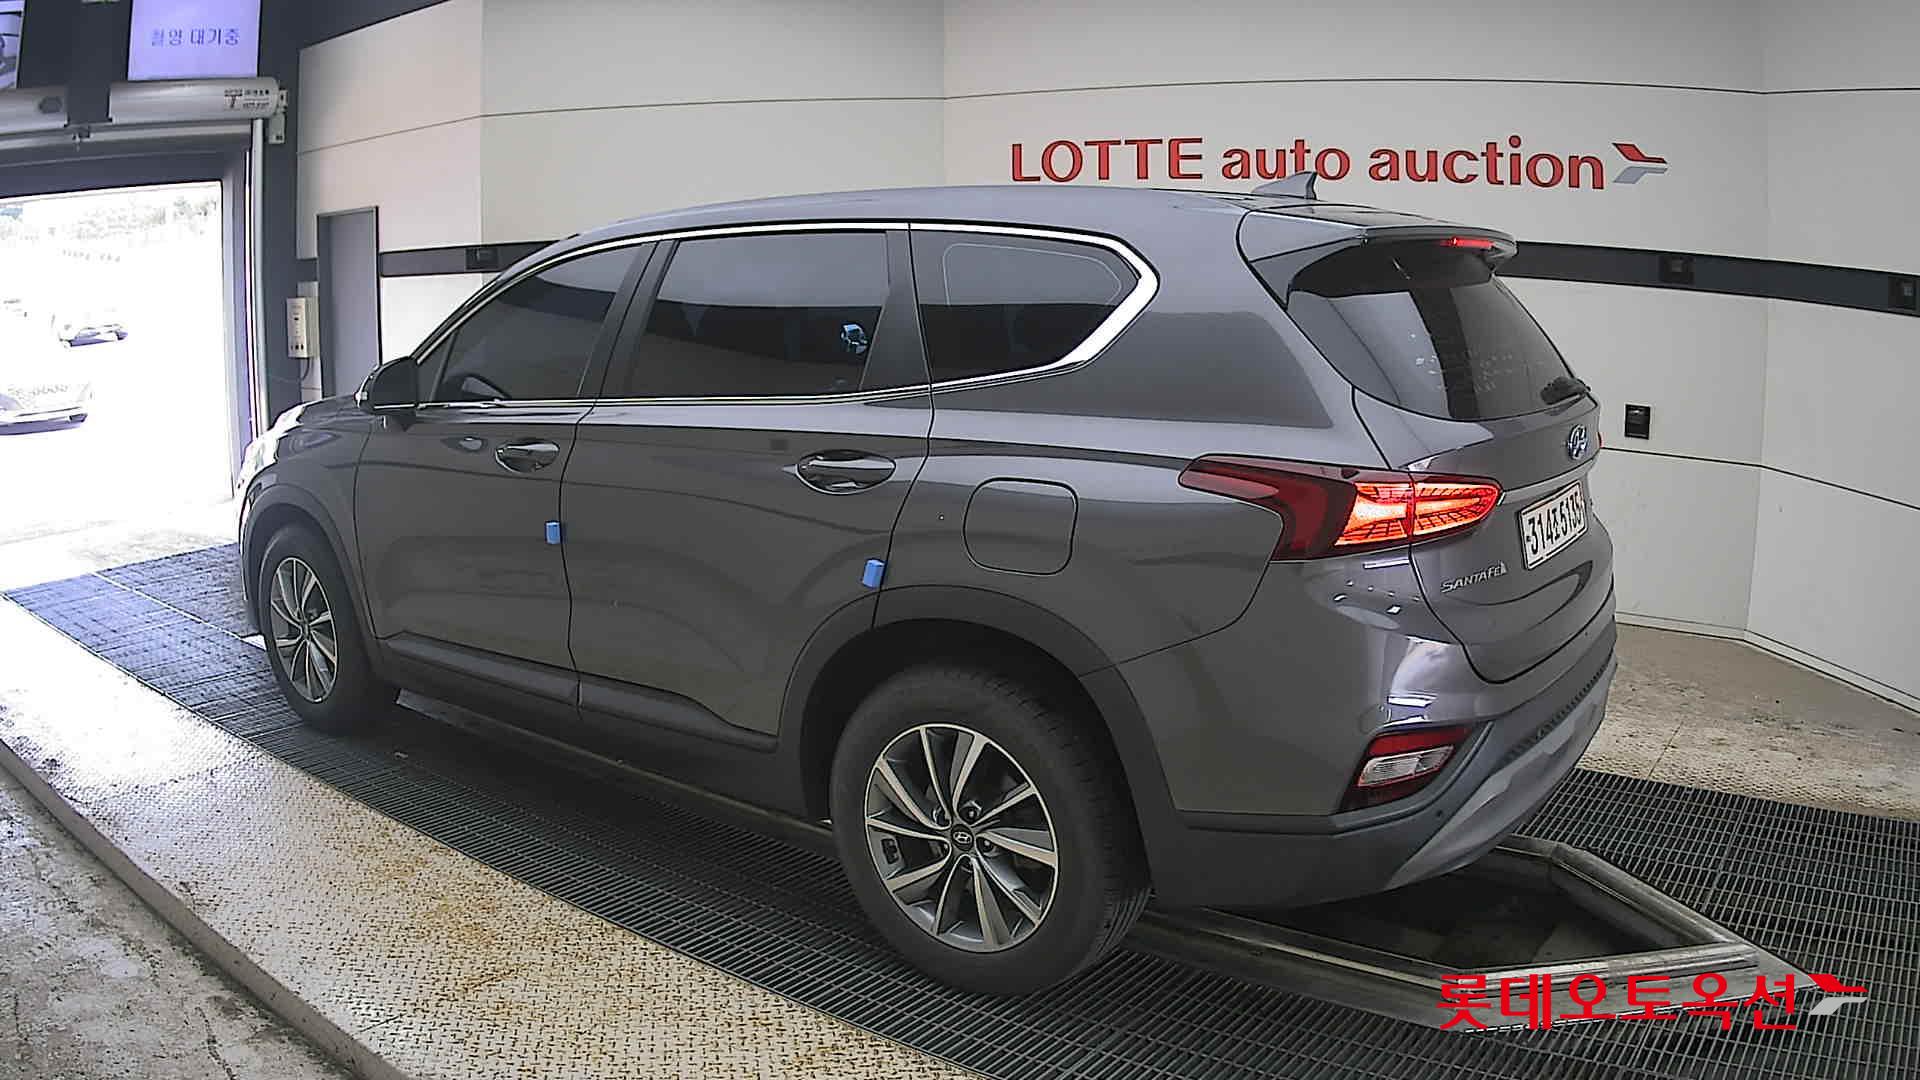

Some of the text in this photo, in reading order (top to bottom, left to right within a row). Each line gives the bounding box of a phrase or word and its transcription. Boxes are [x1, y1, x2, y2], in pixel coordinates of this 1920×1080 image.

[190, 27, 240, 46] 대기중
[1011, 134, 1605, 190] LOTTE auto auction
